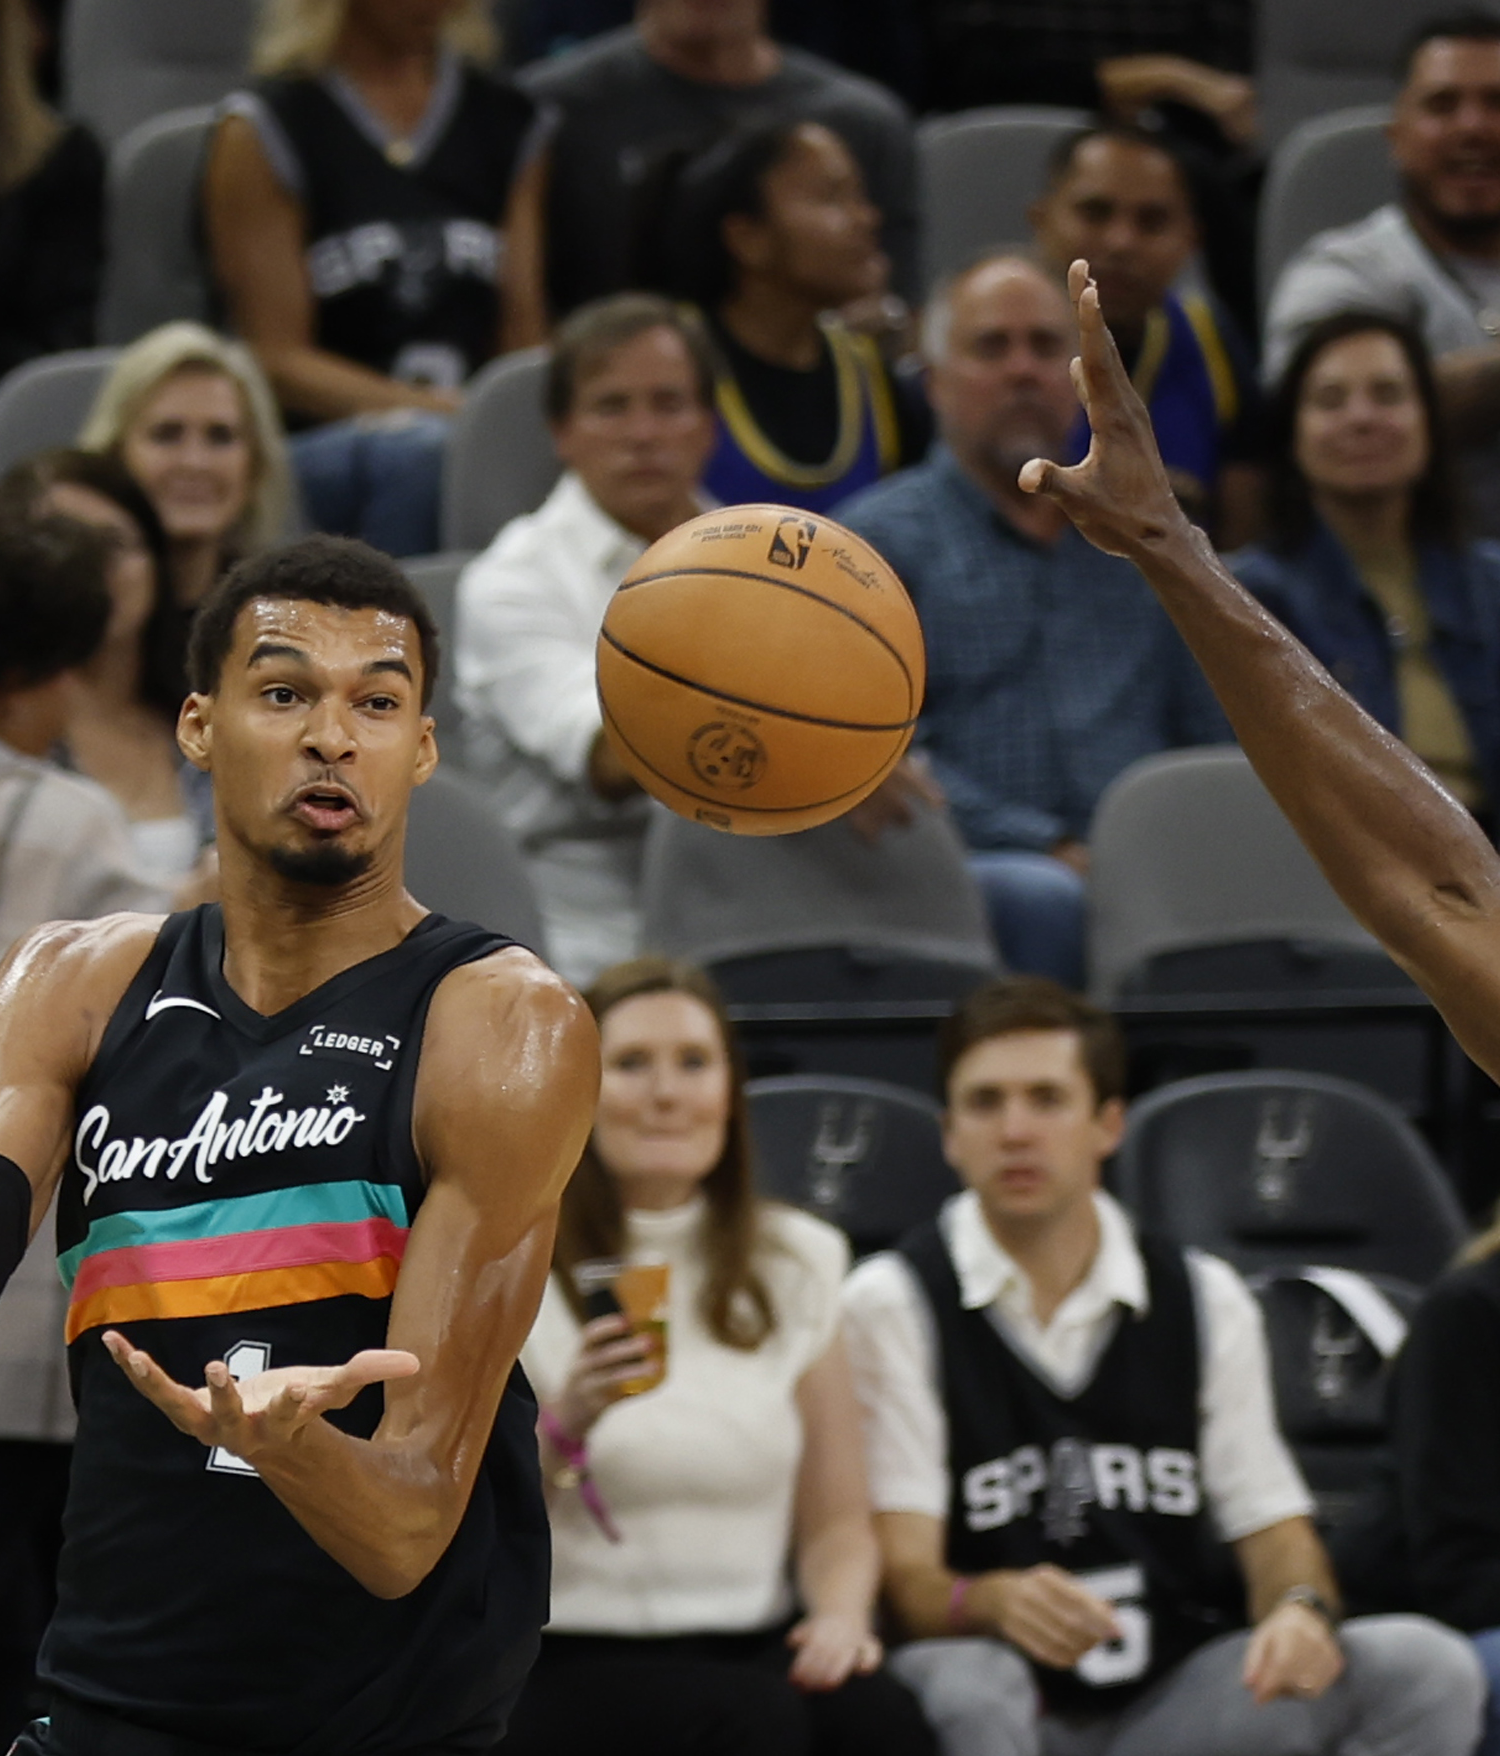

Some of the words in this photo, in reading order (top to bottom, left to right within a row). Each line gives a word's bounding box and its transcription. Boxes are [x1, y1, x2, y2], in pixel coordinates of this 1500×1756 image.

[314, 1031, 385, 1057] LEDGER
[76, 1105, 170, 1206] San
[167, 1086, 365, 1183] Antonio
[963, 1437, 1199, 1542] SPURS
